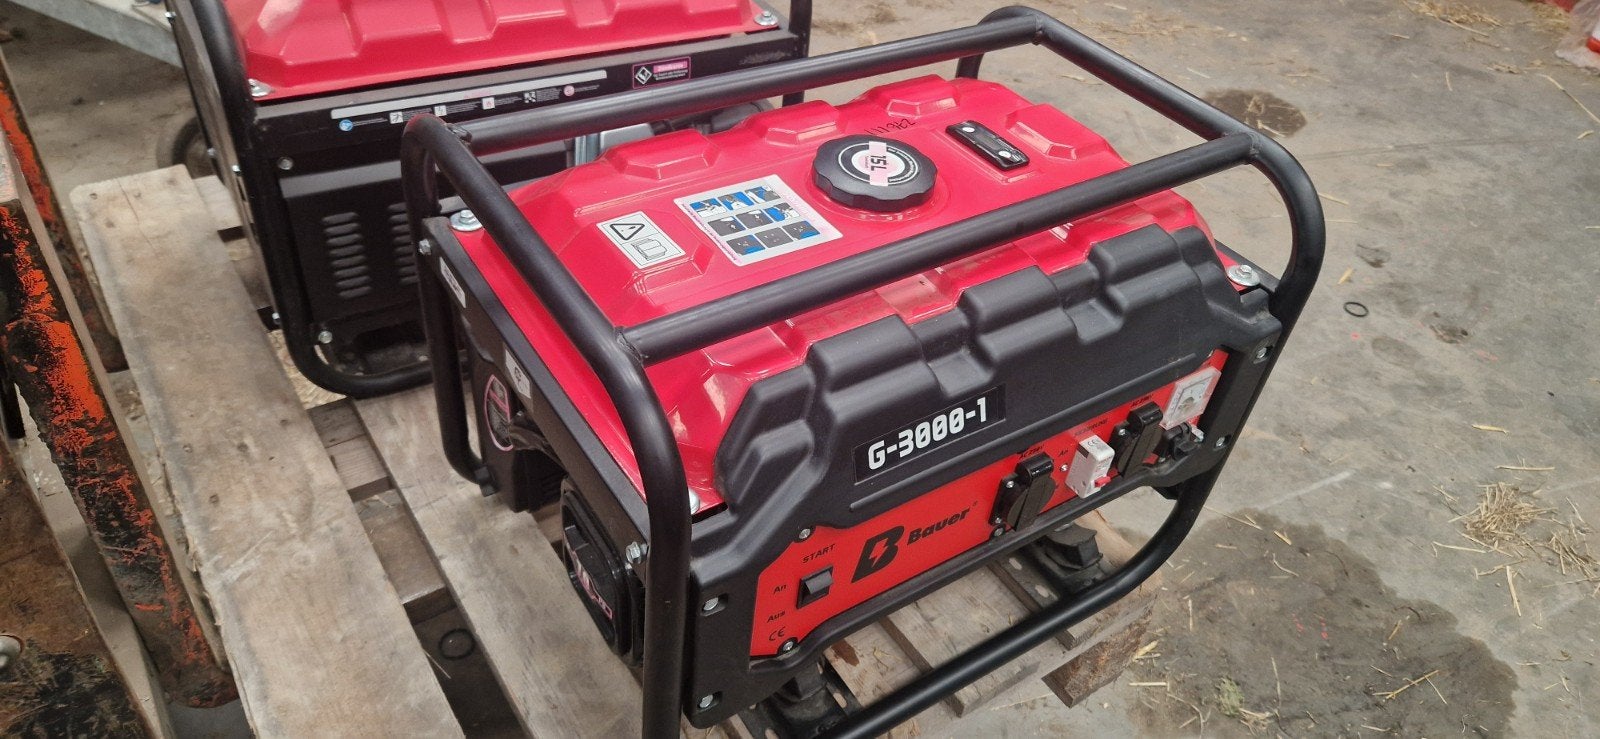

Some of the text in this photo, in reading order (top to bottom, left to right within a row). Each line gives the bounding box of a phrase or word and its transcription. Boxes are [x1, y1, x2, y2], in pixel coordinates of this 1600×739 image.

[870, 155, 887, 172] 15L
[868, 396, 987, 470] G-3000-1
[906, 507, 971, 546] Bauer
[801, 543, 837, 565] START
[772, 583, 788, 595] An
[766, 610, 787, 623] Aus
